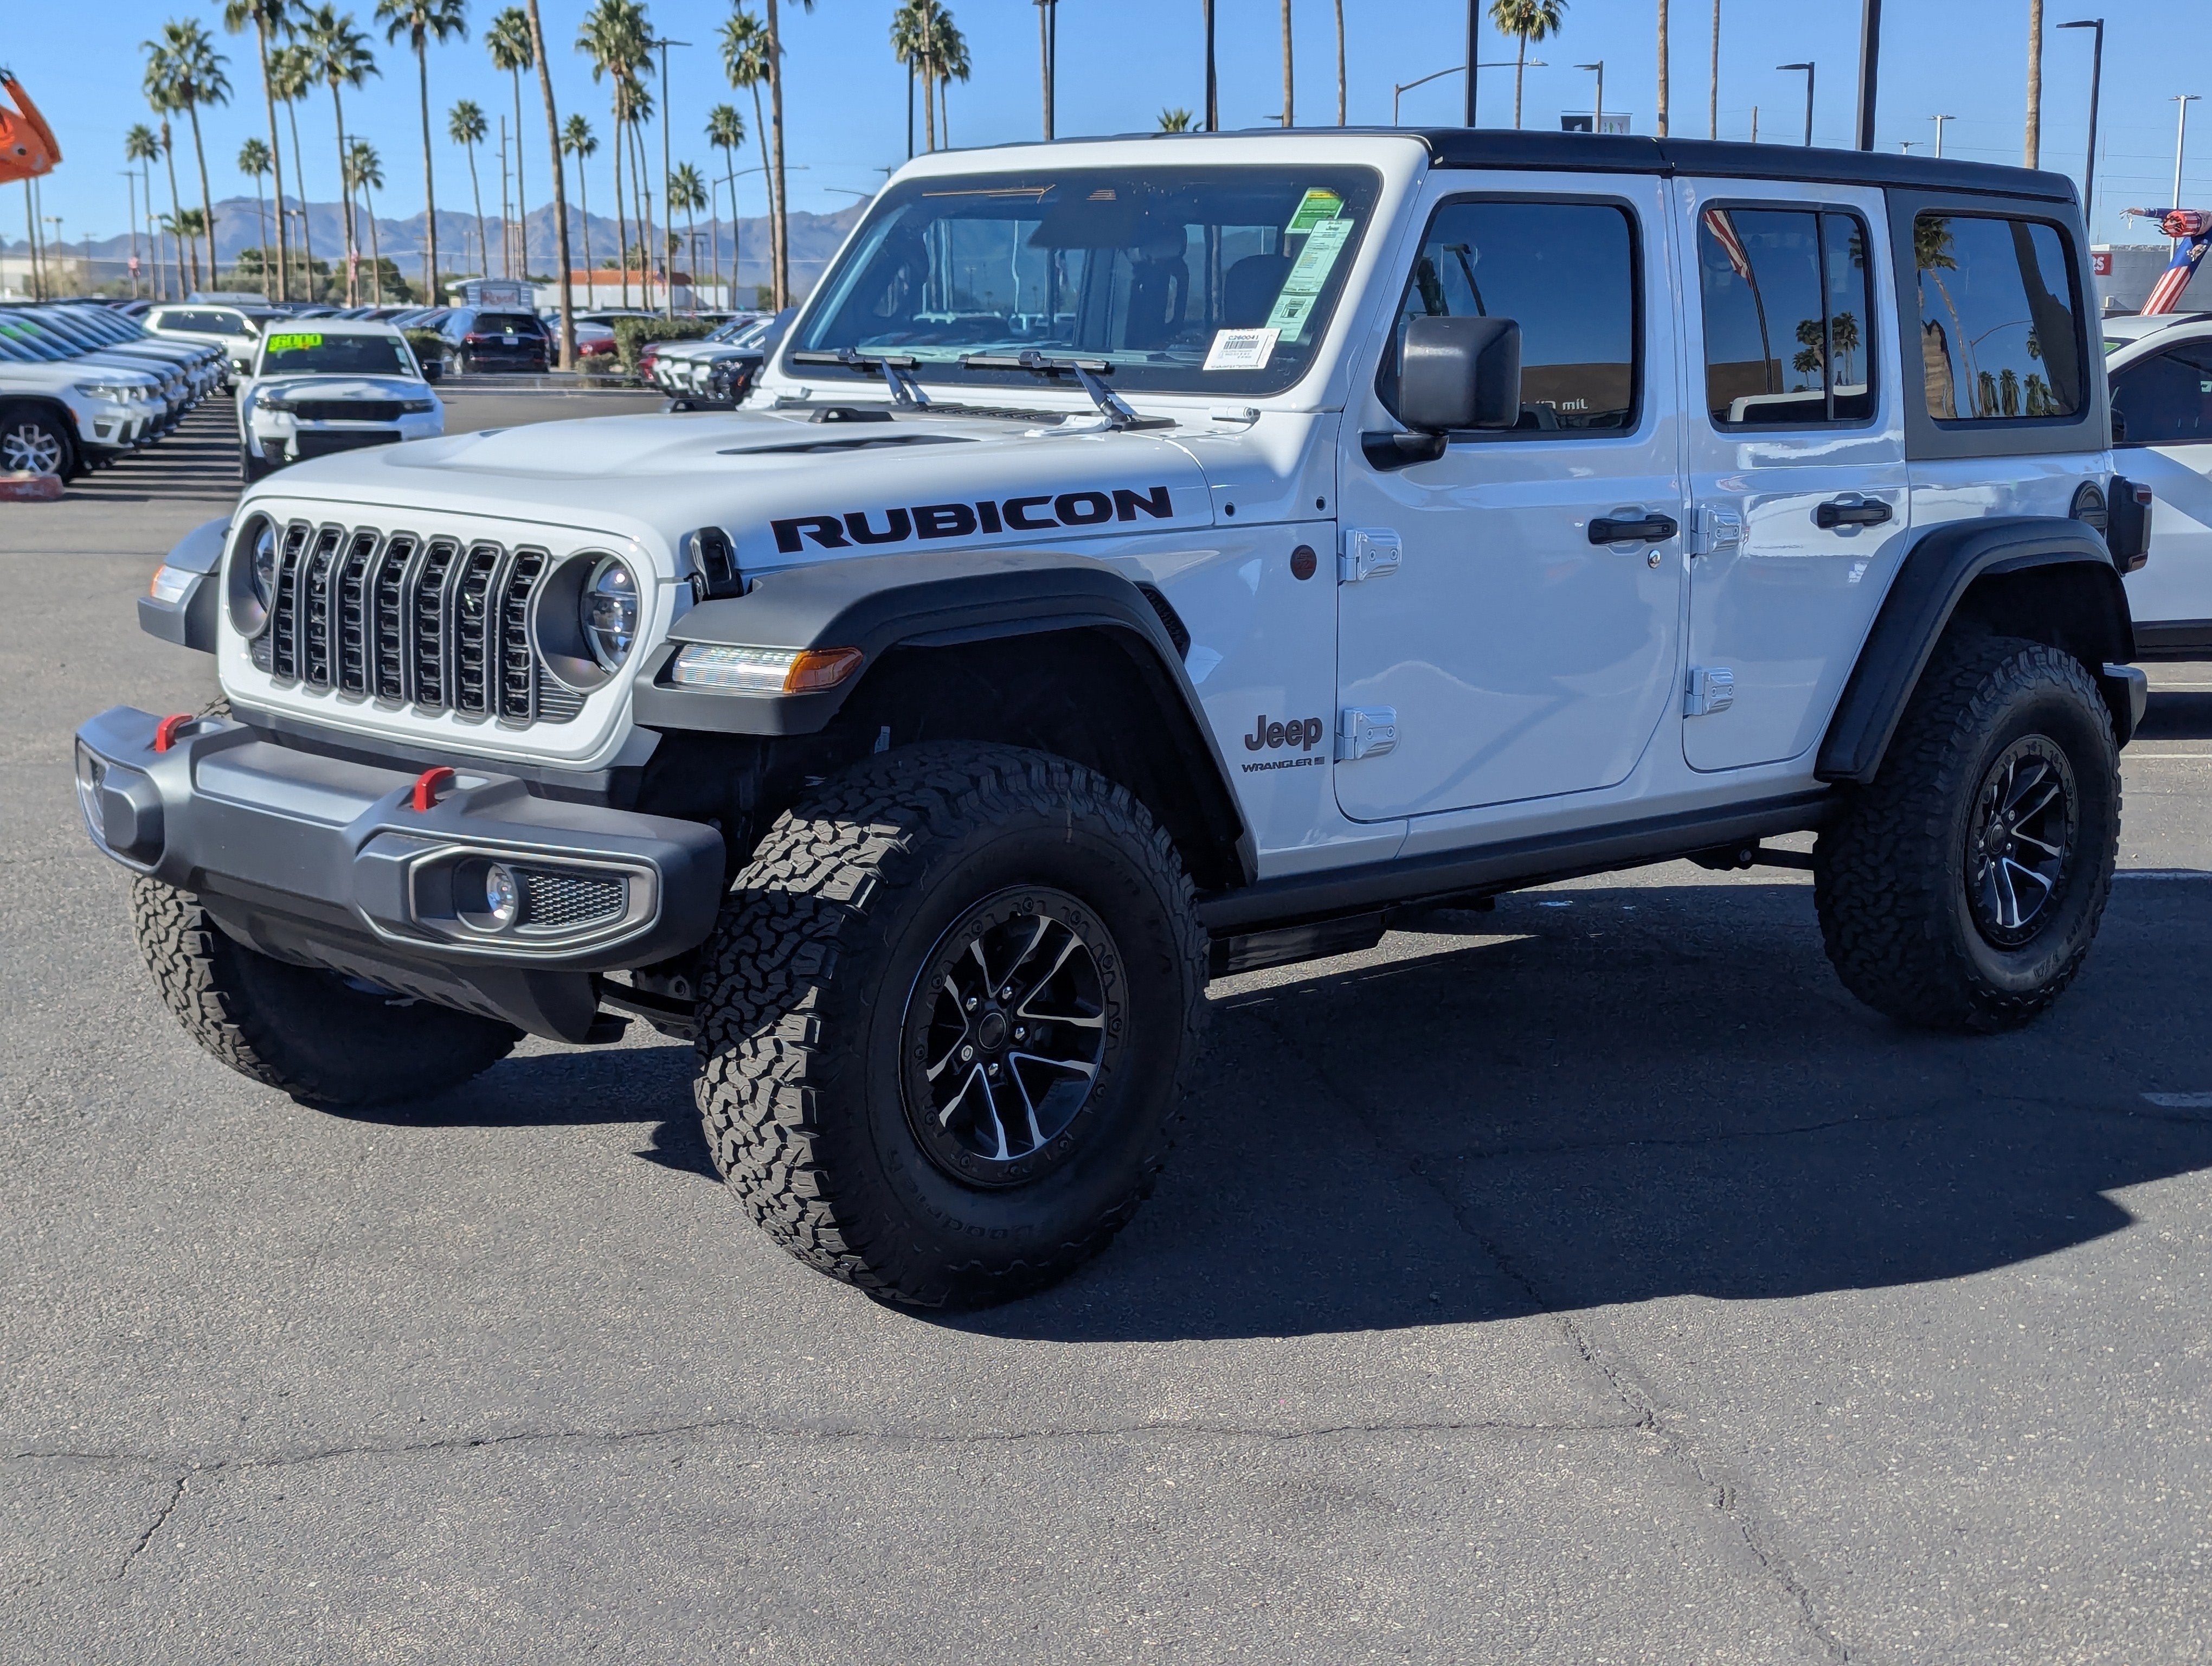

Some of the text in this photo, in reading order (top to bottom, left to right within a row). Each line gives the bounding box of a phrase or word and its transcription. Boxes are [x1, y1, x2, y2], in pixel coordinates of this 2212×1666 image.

[770, 486, 1173, 553] RUBICON
[1245, 714, 1323, 752] Jeep
[1242, 758, 1313, 773] WRANGLER
